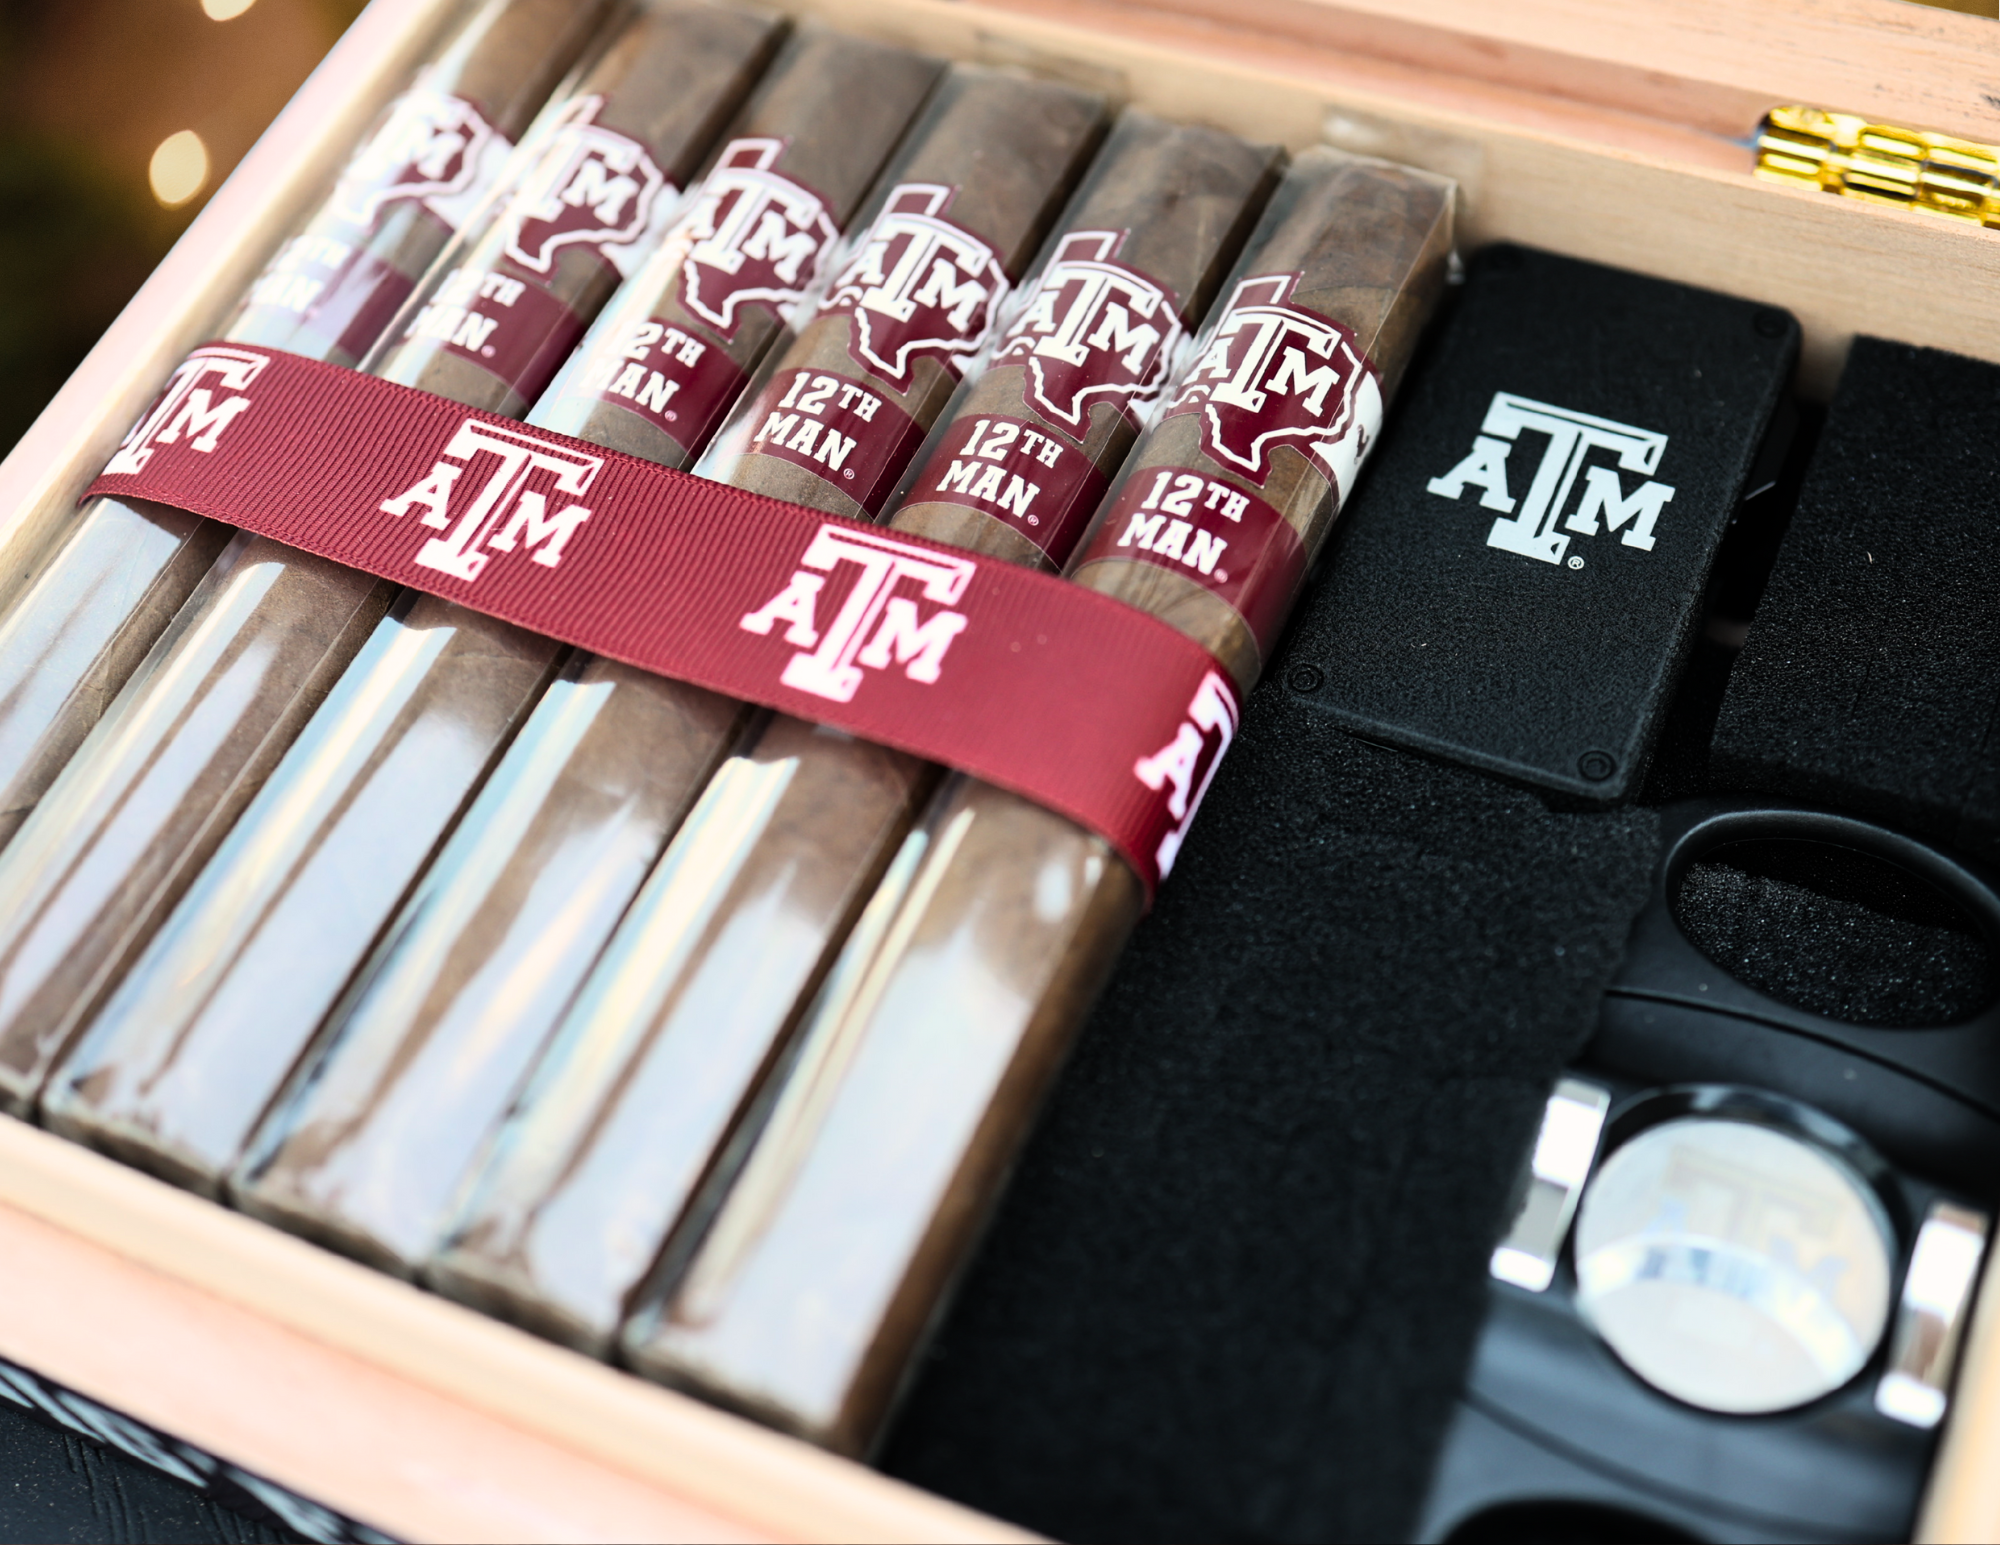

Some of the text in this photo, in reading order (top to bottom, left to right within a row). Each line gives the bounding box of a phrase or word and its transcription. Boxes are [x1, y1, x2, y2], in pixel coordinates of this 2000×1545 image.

[1182, 306, 1342, 418] ATM
[778, 372, 883, 422] 12TH
[754, 412, 857, 471] MAN
[959, 419, 1064, 469] 12TH
[379, 418, 605, 583] ATM
[936, 460, 1040, 518] MAN
[1141, 471, 1250, 523] 12TH
[1427, 391, 1676, 566] ATM
[1117, 513, 1228, 576] MAN
[739, 523, 977, 704] ATM
